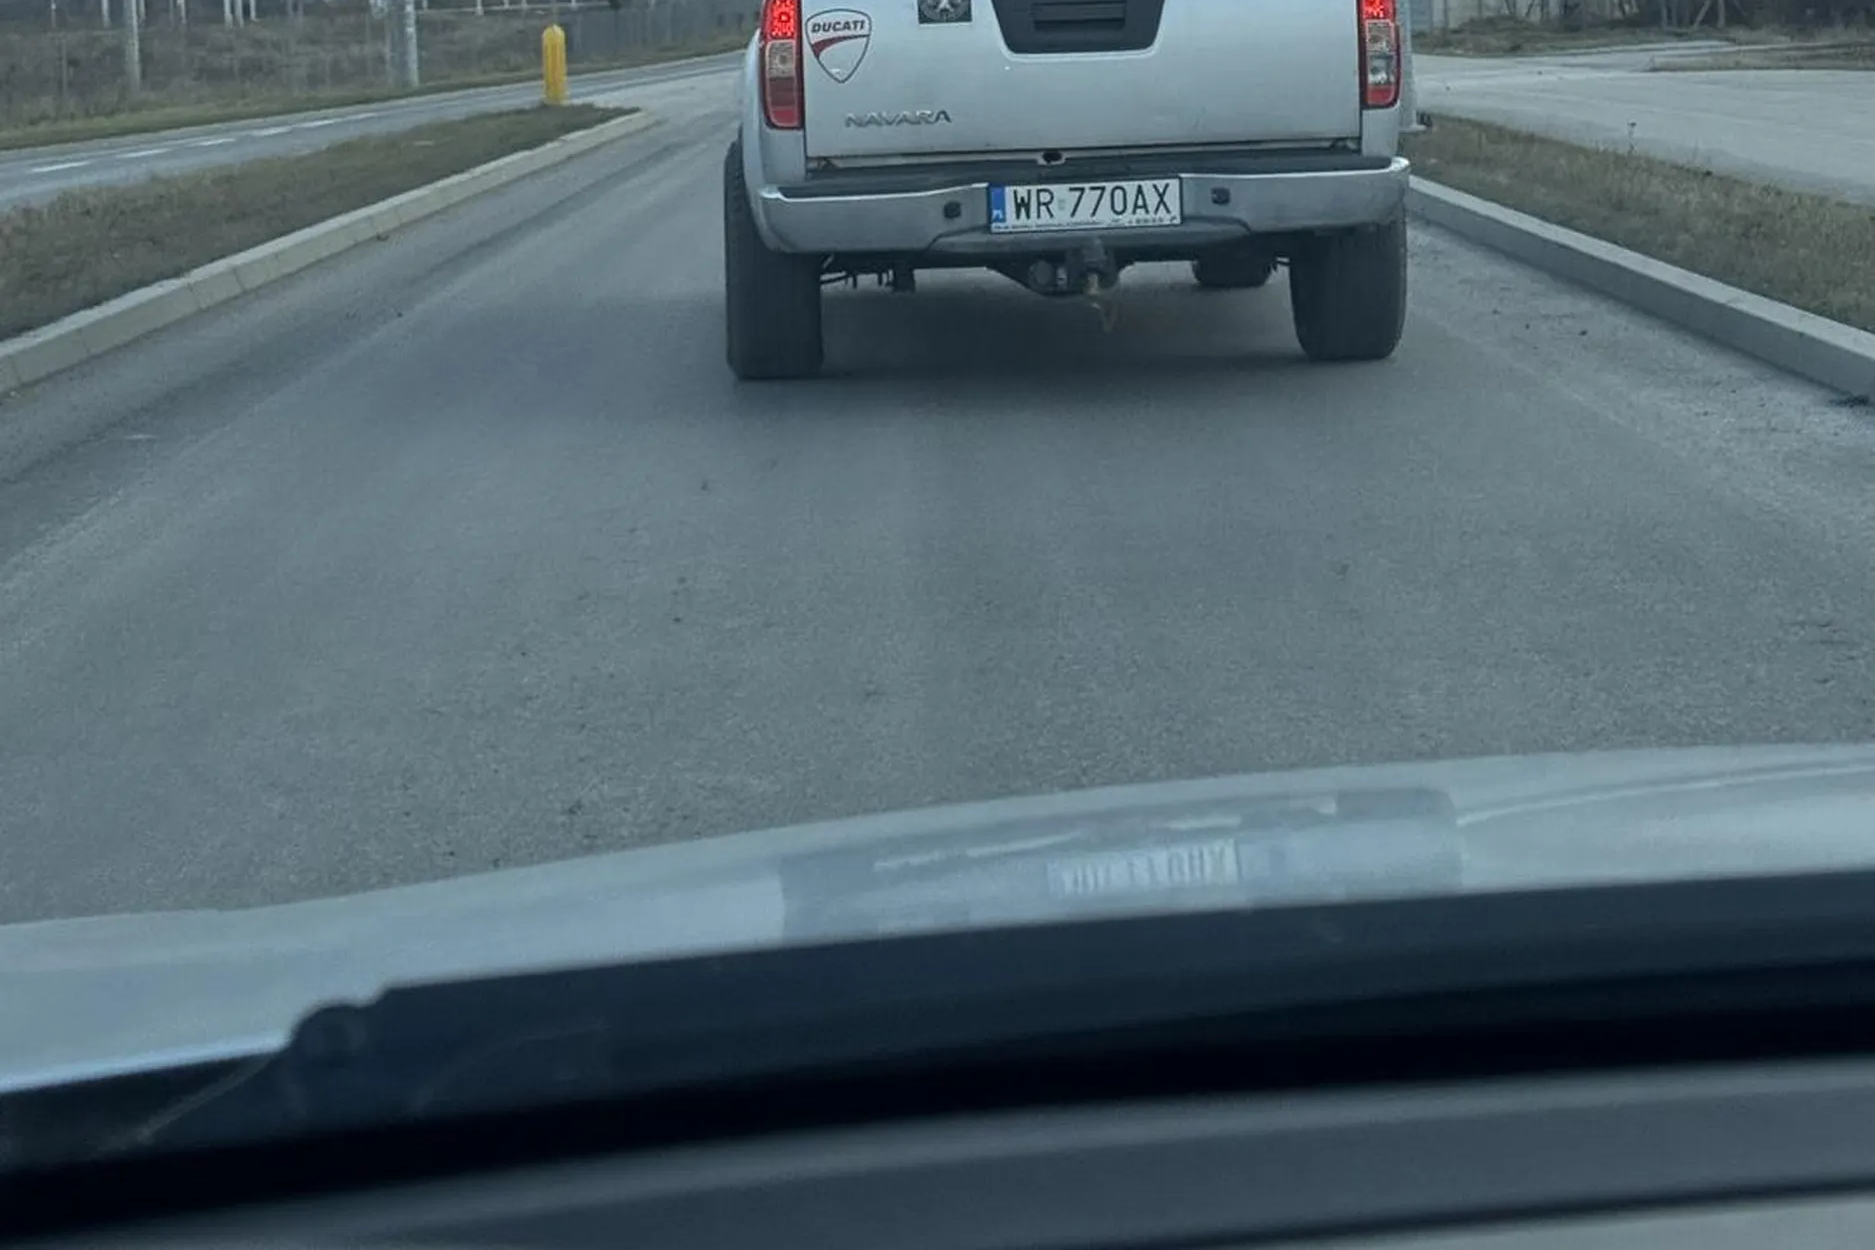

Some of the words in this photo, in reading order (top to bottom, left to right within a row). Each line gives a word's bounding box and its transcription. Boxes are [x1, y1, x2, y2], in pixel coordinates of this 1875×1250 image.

[811, 19, 866, 34] DUCATI
[844, 109, 952, 128] NAVARA
[1013, 187, 1055, 220] WR
[1069, 182, 1172, 218] 770AX
